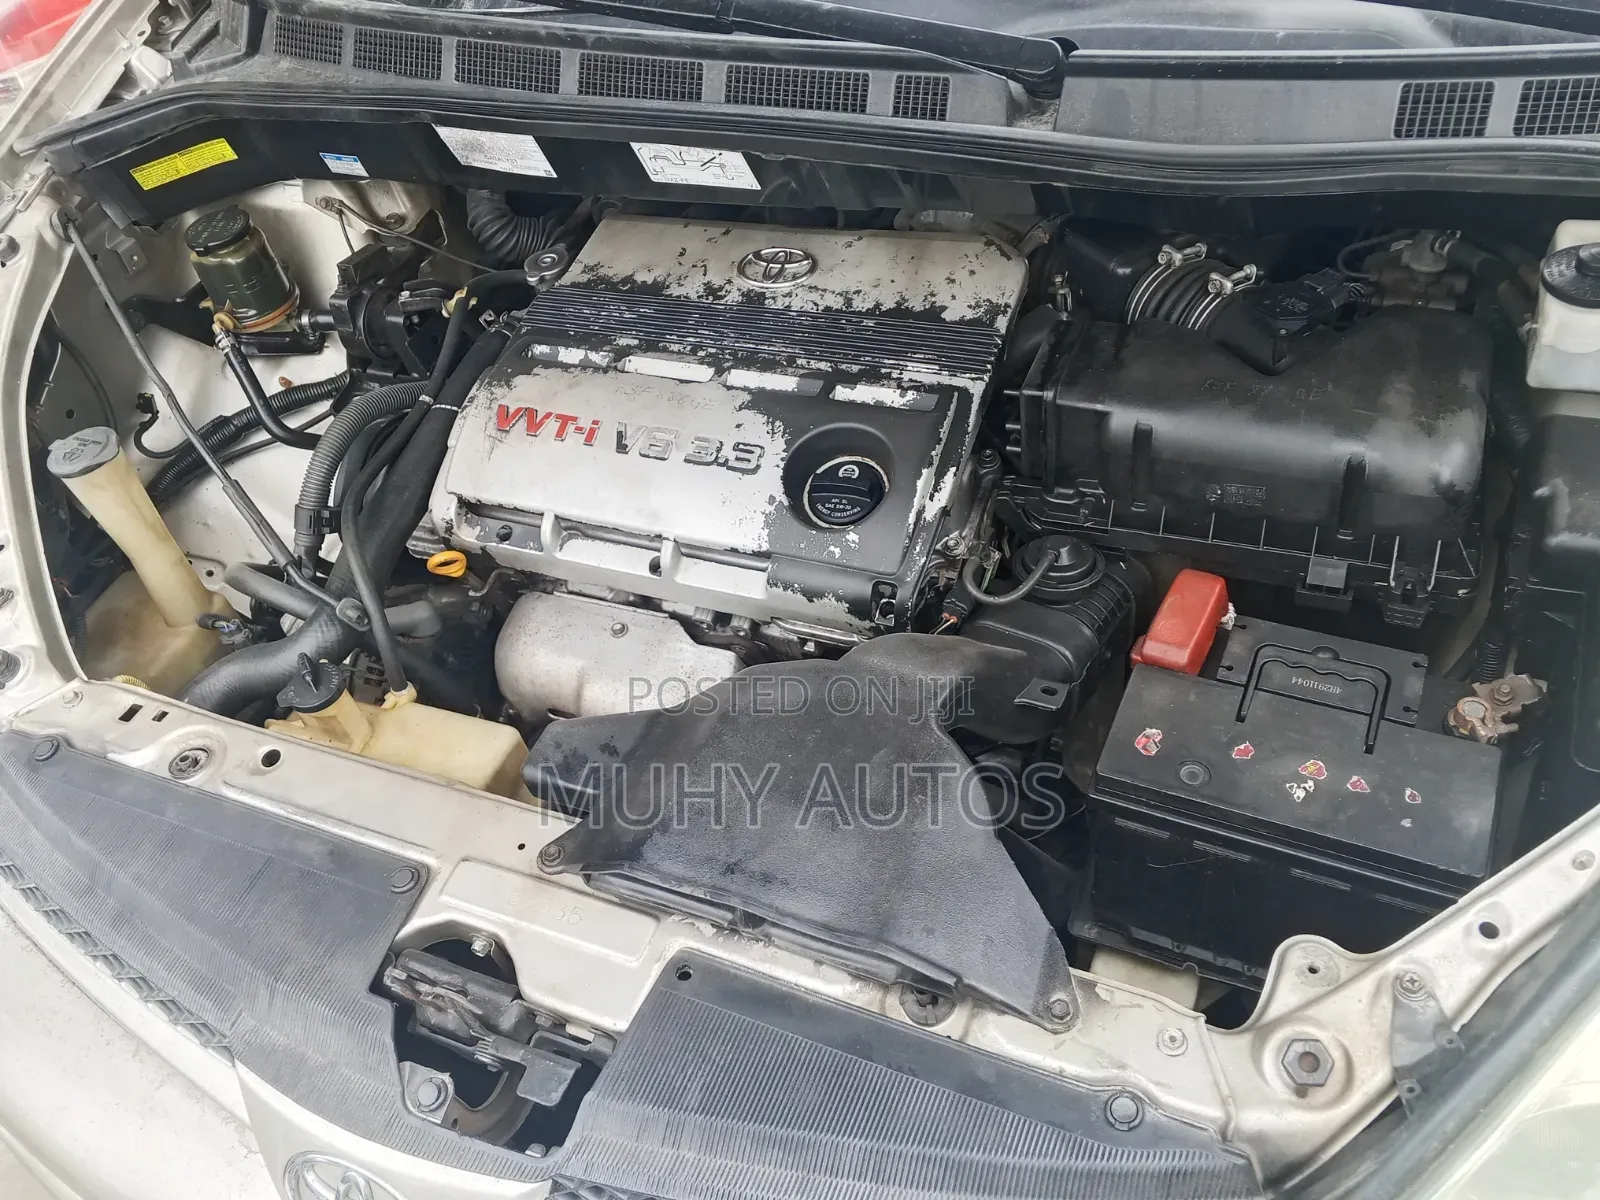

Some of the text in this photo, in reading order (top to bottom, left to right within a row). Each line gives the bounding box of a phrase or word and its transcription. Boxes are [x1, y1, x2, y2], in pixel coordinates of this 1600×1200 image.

[496, 403, 766, 475] VVT-i V6 3.3
[816, 503, 861, 517] ENERGY CONSERVING
